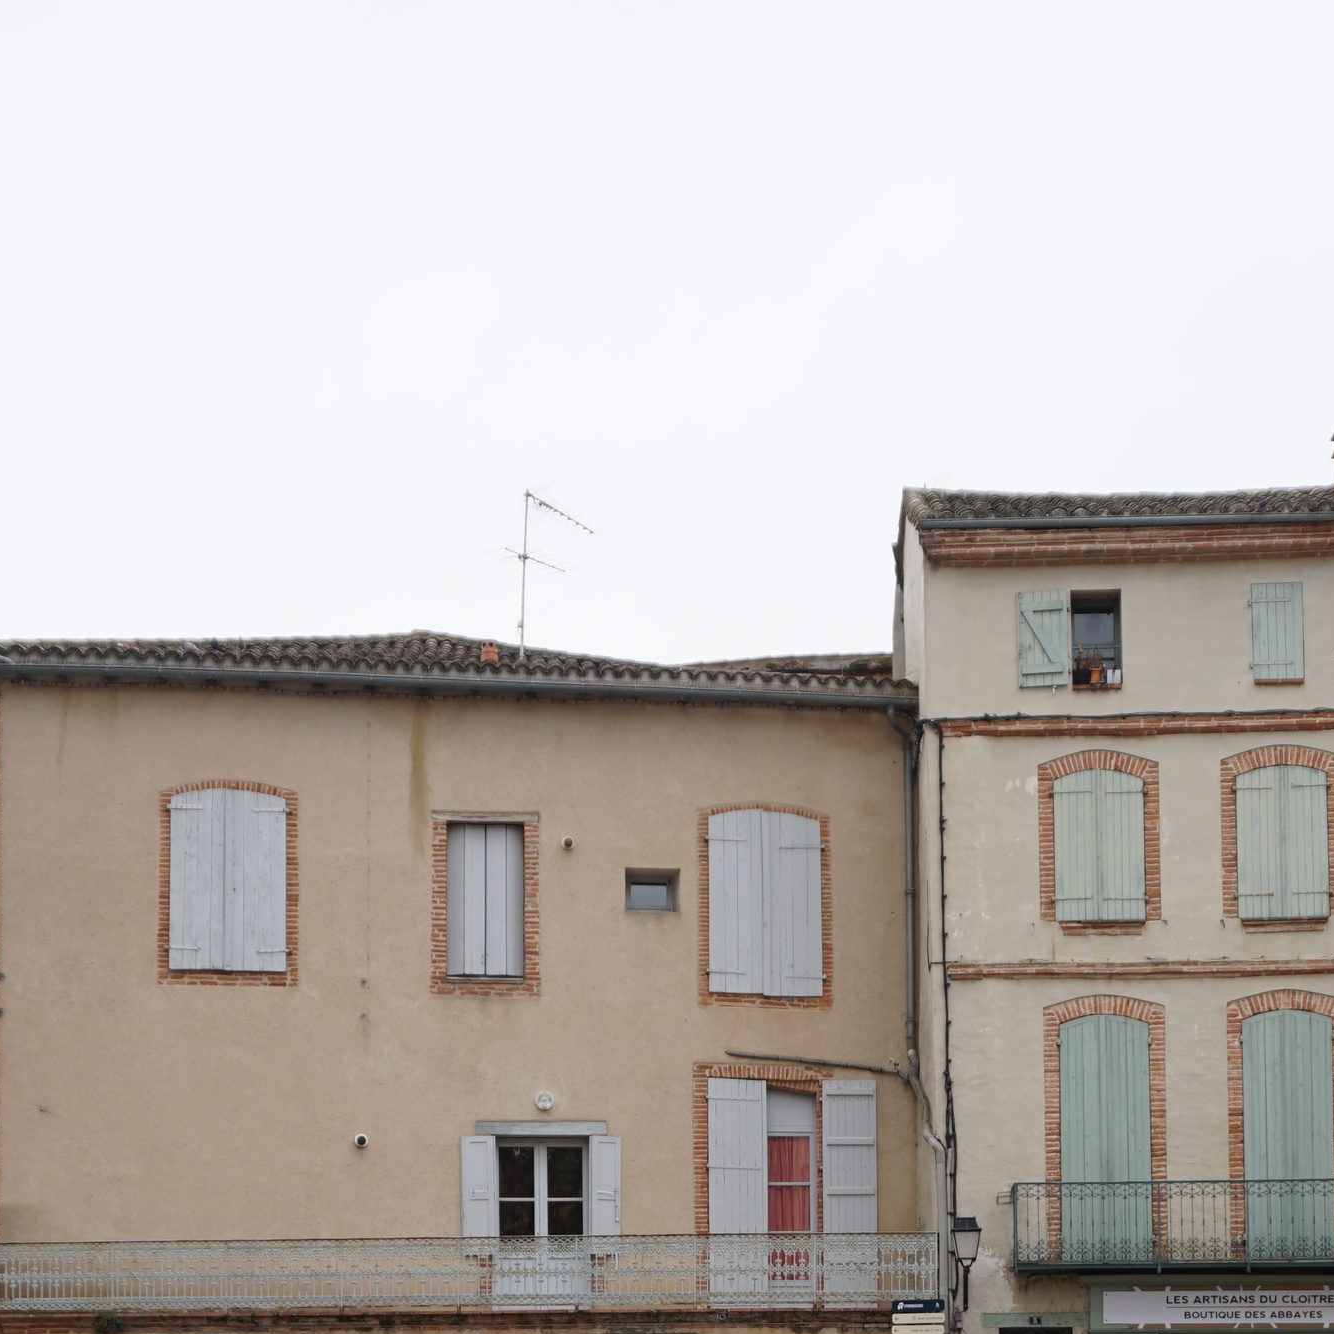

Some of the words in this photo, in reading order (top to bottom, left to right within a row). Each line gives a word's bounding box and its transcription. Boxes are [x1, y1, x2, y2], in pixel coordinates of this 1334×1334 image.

[1166, 1295, 1189, 1305] LES
[1193, 1295, 1256, 1304] ARTISANS
[1260, 1295, 1277, 1304] DU
[1184, 1311, 1241, 1320] BOUTIQUE
[1244, 1311, 1266, 1319] DES
[1270, 1310, 1323, 1319] ABBAYES
